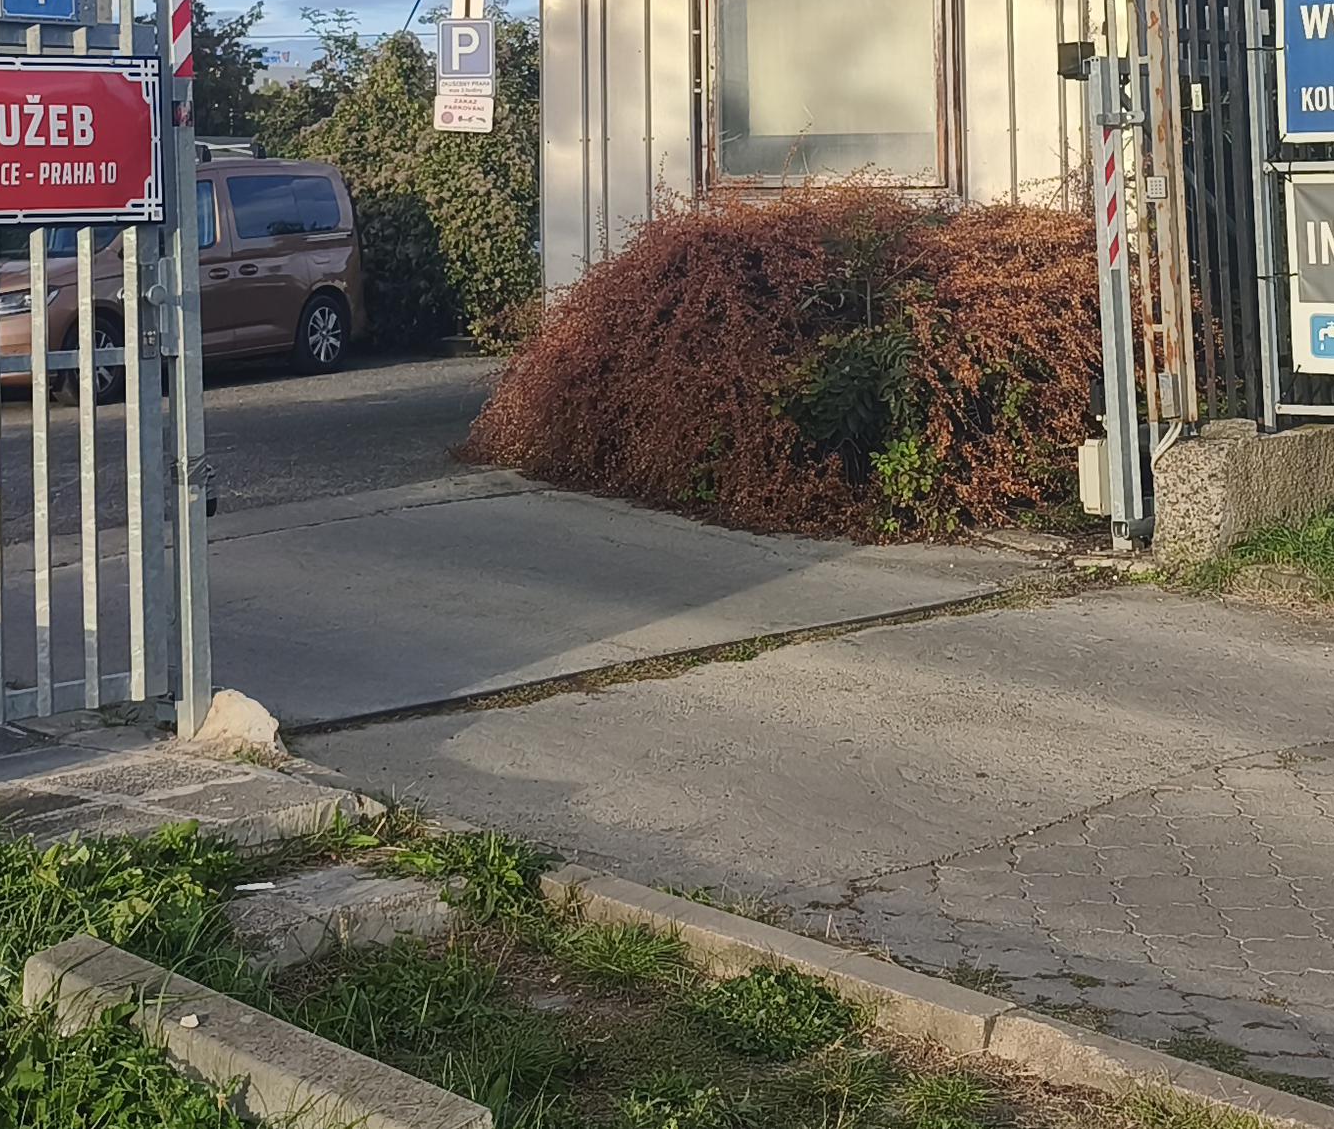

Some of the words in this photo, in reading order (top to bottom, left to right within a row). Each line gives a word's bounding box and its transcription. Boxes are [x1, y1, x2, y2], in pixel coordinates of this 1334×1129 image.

[451, 26, 480, 71] P
[39, 161, 95, 185] PRAHA
[99, 161, 118, 185] 10
